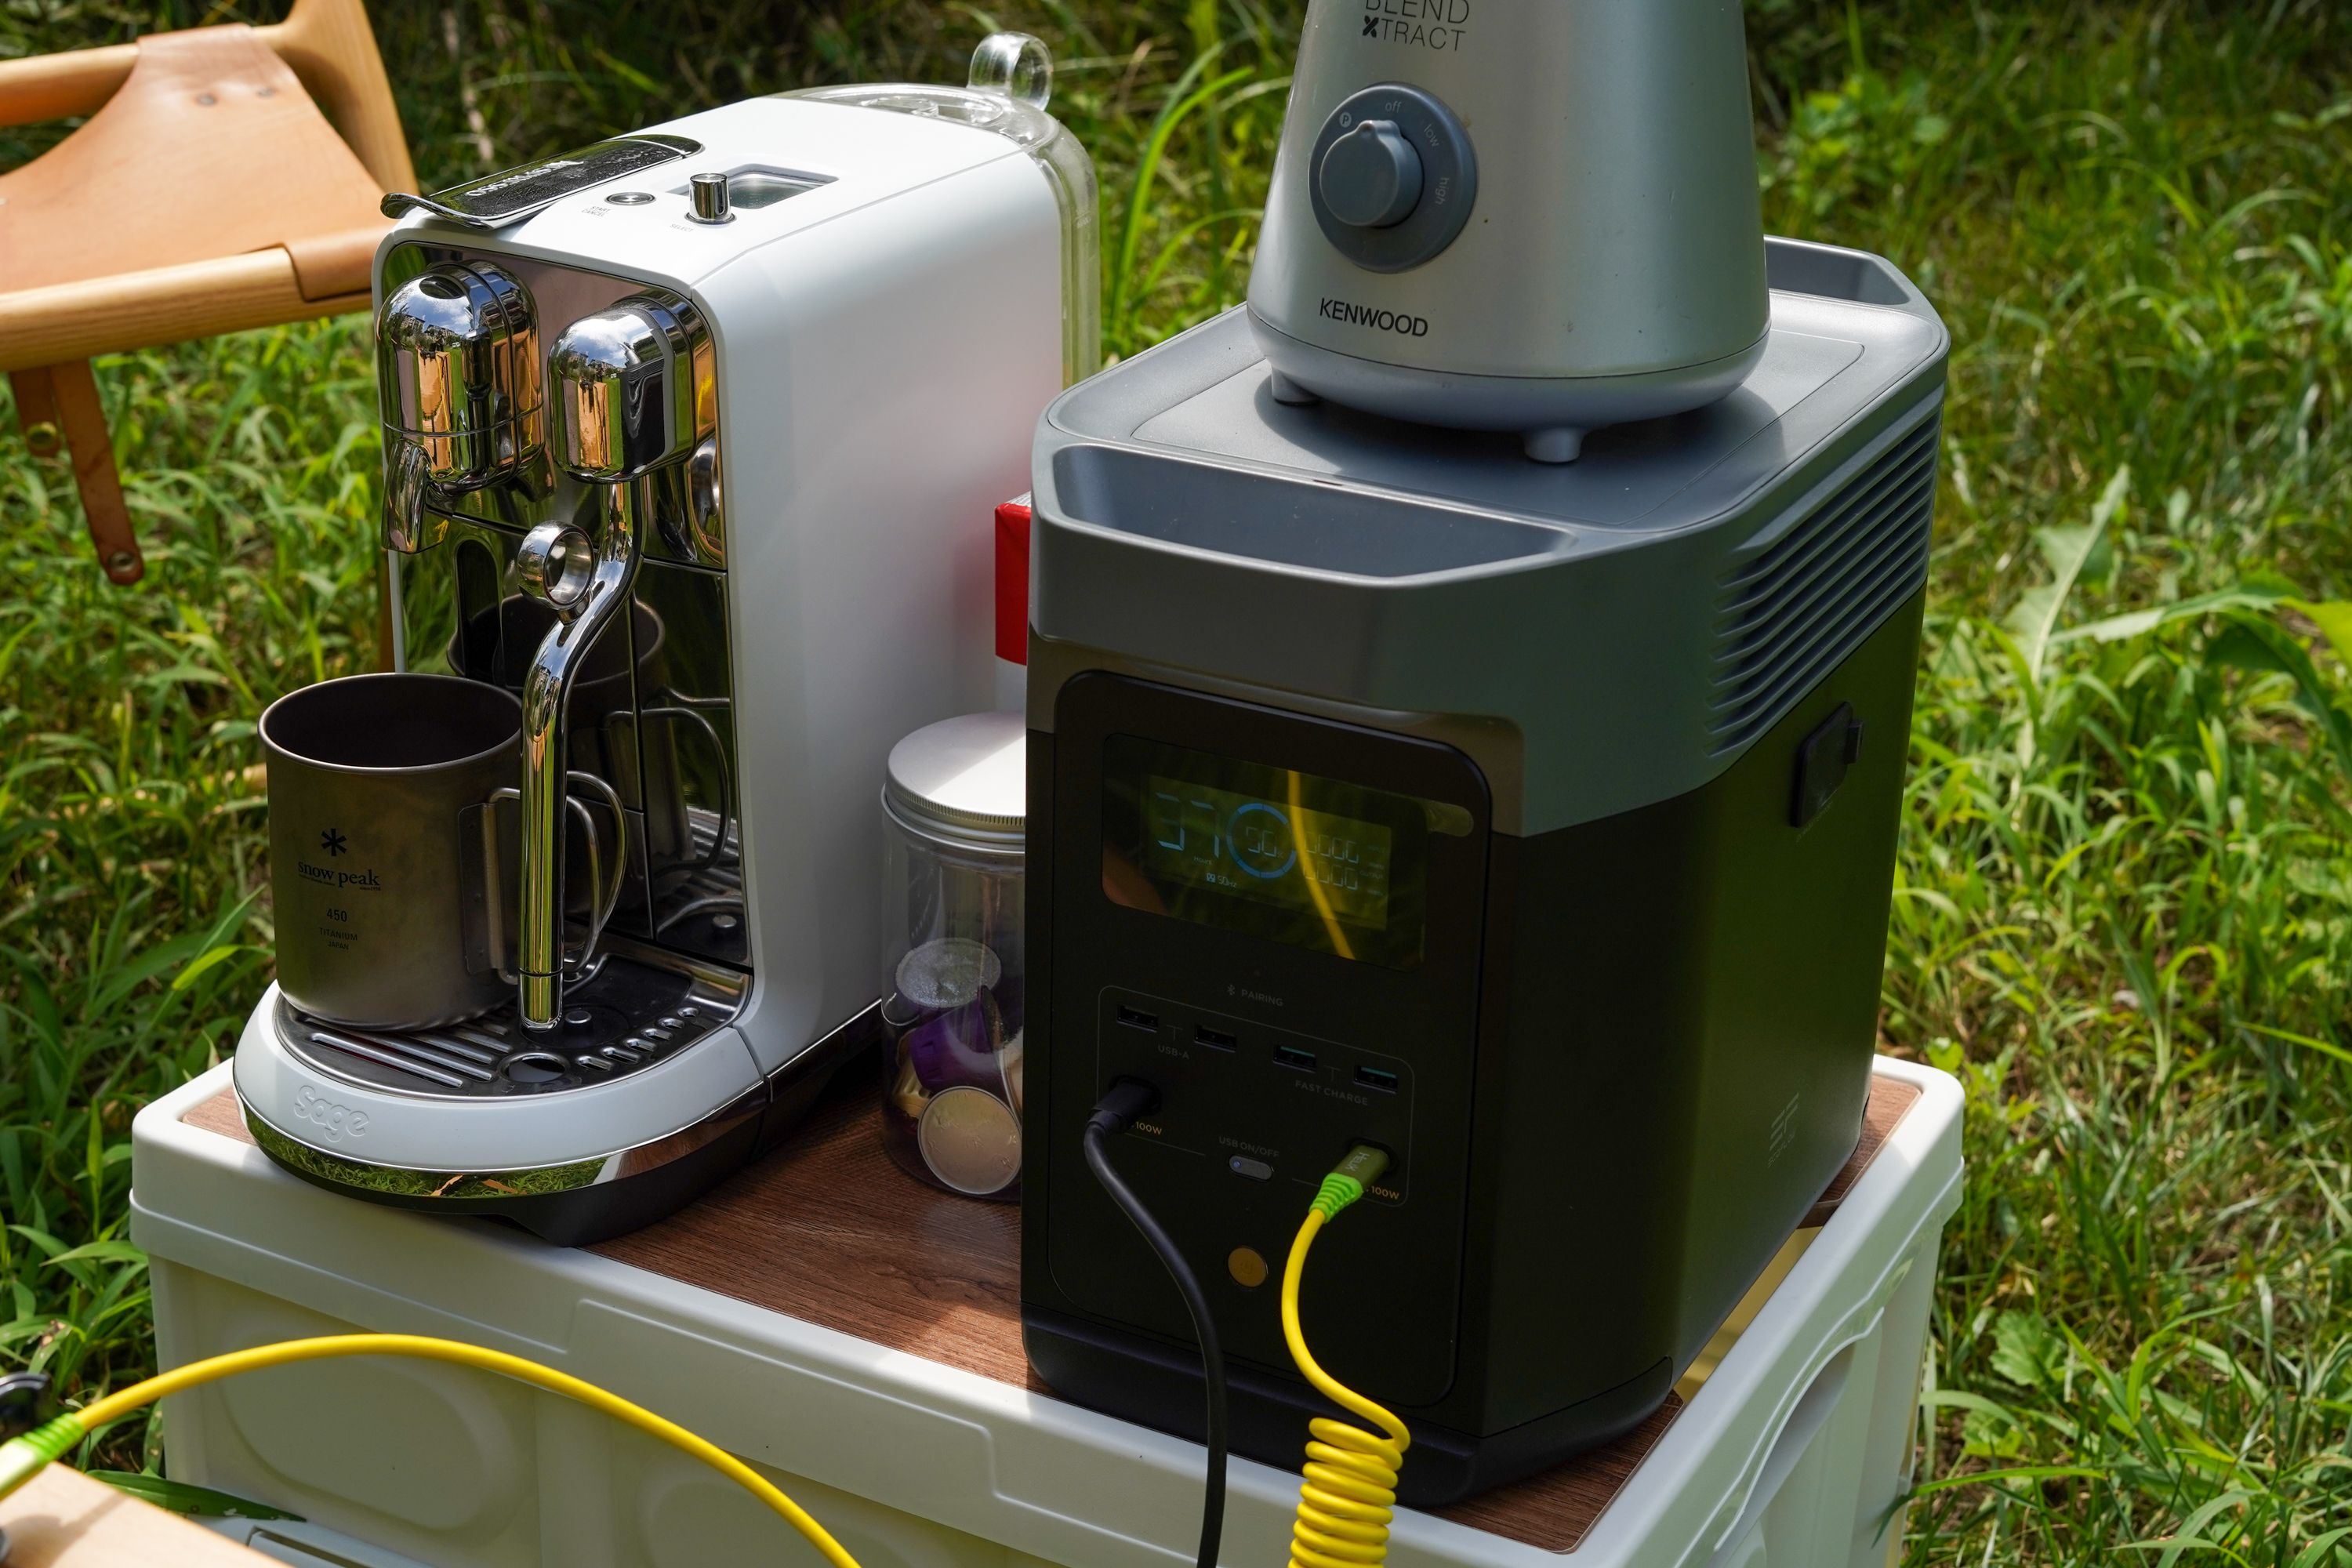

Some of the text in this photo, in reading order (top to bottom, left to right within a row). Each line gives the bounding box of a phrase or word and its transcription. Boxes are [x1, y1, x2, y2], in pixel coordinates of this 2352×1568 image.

[1362, 15, 1467, 51] XTRACT
[1385, 100, 1402, 113] off
[1423, 123, 1440, 147] low
[1435, 177, 1450, 205] high
[670, 223, 694, 233] SELECT
[1319, 297, 1428, 337] KENWOOD
[298, 861, 335, 880] snow
[338, 868, 381, 888] peak
[326, 907, 347, 923] 450
[319, 927, 358, 941] TITANIUM
[327, 940, 350, 950] JAPAN
[1240, 989, 1283, 1007] PAIRING
[1157, 1044, 1190, 1060] USB-A
[1295, 1079, 1369, 1106] FAST CHARGE
[293, 1084, 370, 1143] sage
[1135, 1121, 1163, 1136] 100W
[1218, 1136, 1280, 1158] USB ON/OFF
[1370, 1185, 1399, 1200] 100W
